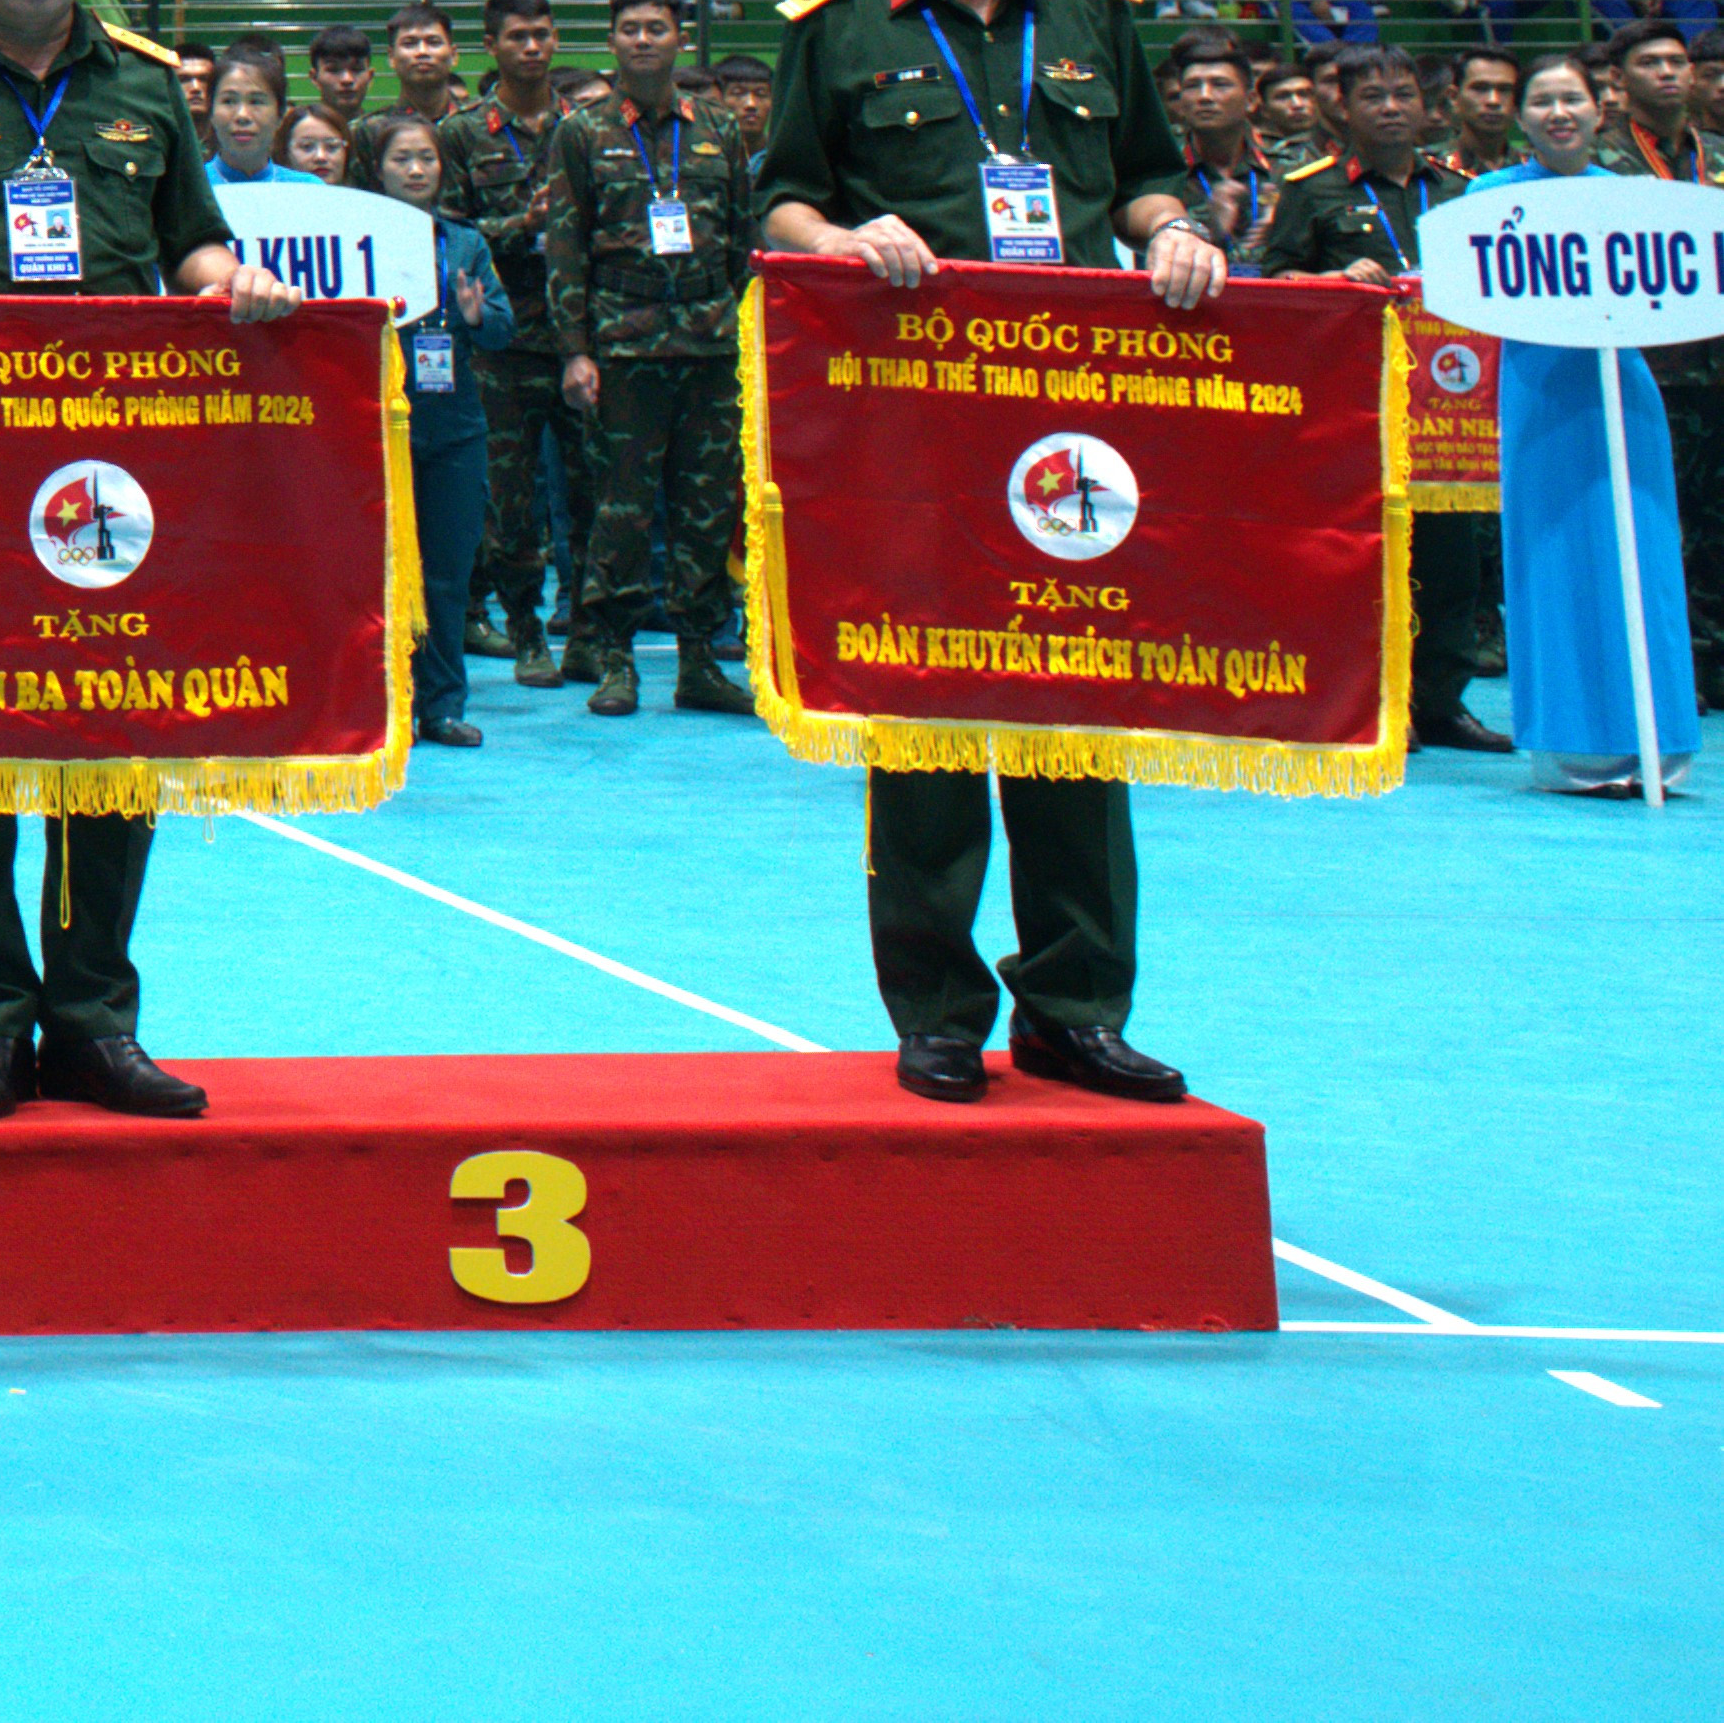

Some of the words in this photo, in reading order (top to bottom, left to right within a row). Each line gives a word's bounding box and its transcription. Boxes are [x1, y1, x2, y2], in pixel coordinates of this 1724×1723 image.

[256, 234, 343, 299] KHU
[356, 234, 376, 297] 1
[1469, 206, 1593, 299] TỔNG
[1605, 230, 1699, 310] CỤC
[104, 343, 241, 377] PHÒNG
[897, 308, 954, 350] BỘ
[966, 312, 1080, 355] QUỐC
[1091, 319, 1234, 361] PHÒNG
[2, 397, 56, 428] THAO
[61, 386, 119, 430] QUỐC
[125, 392, 200, 425] PHÒNG
[205, 390, 253, 424] NĂM
[257, 395, 314, 424] 2024
[828, 354, 863, 393] HỘI
[867, 357, 929, 388] THAO
[933, 352, 978, 392] THỂ
[982, 366, 1039, 399] THAO
[1045, 361, 1107, 405] QUỐC
[1111, 370, 1191, 407] PHÒNG
[1196, 376, 1246, 412] NĂM
[1250, 383, 1303, 415] 2024
[1406, 412, 1454, 437] OÀN
[1010, 578, 1130, 612] TẶNG
[33, 610, 148, 642] TẶNG
[837, 614, 920, 667] ĐOÀN
[927, 615, 1042, 674] KHUYẾN
[1048, 623, 1134, 679] KHÍCH
[1140, 634, 1220, 687] TOÀN
[1224, 640, 1306, 697] QUÂN
[15, 669, 69, 711] BA
[74, 656, 177, 711] TOÀN
[183, 655, 288, 717] QUÂN
[449, 1150, 591, 1303] 3
